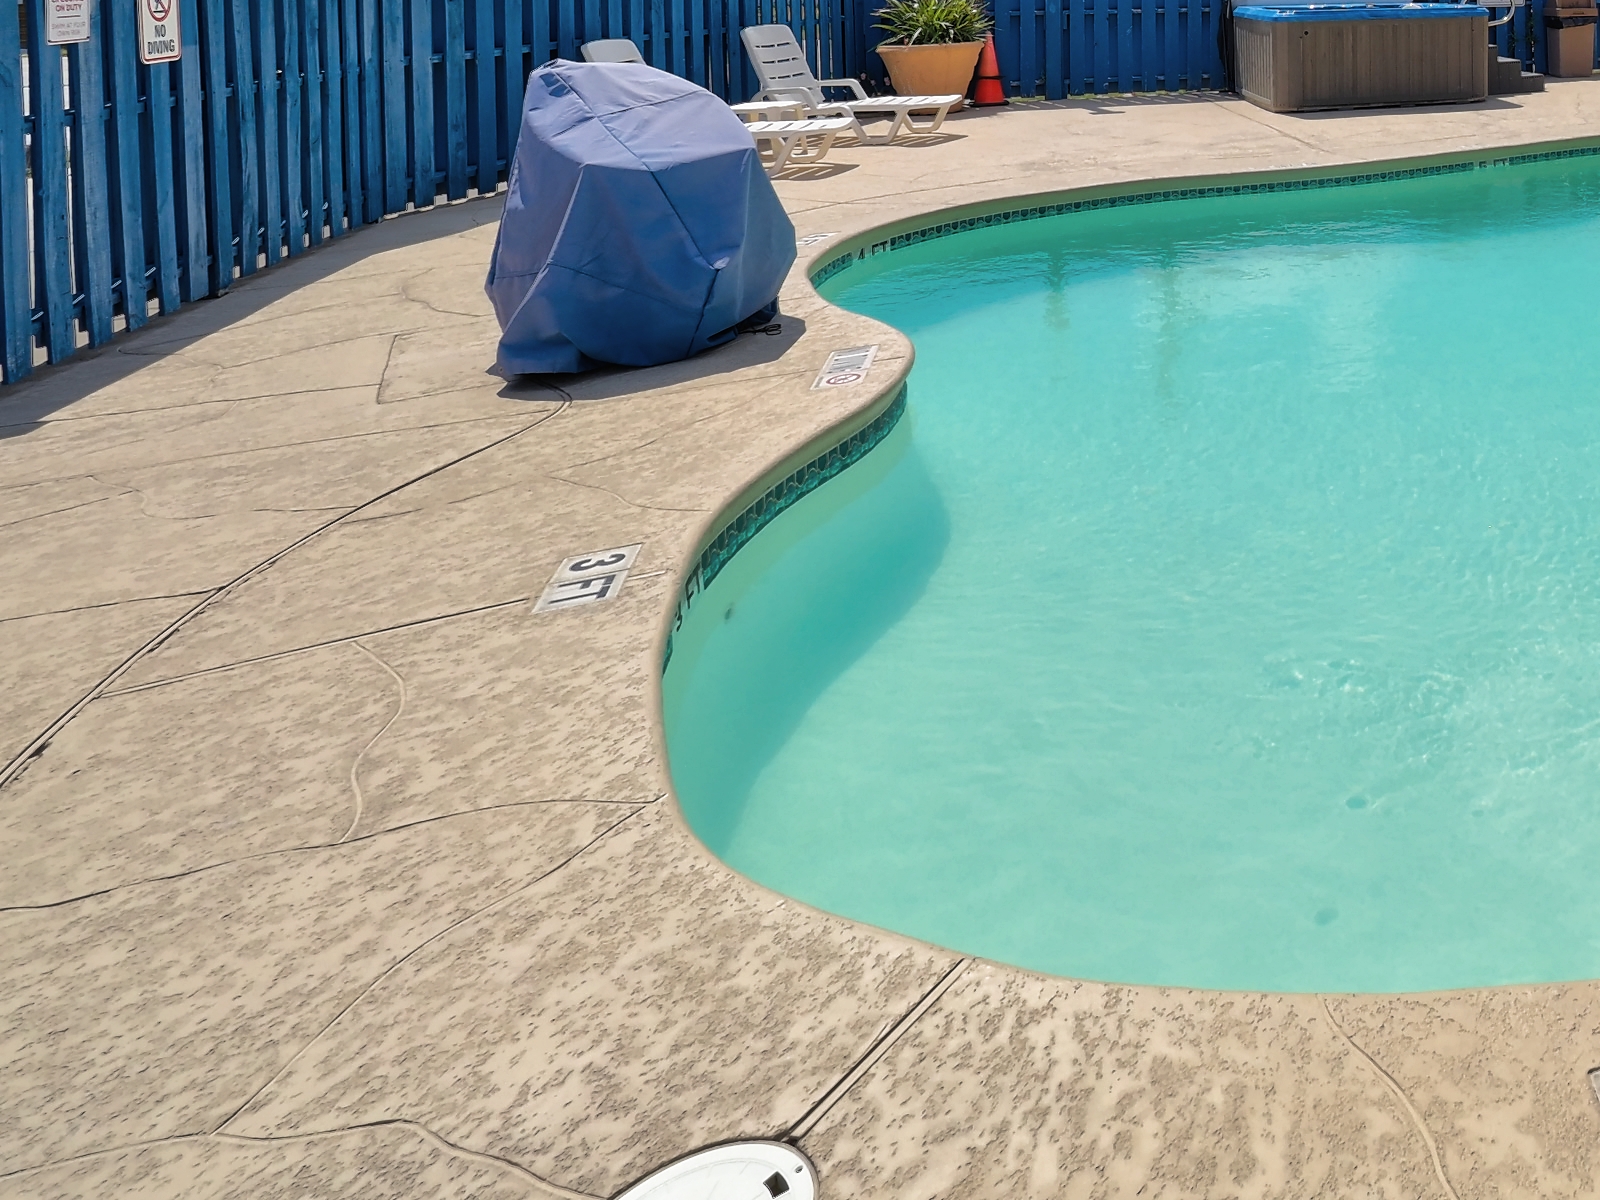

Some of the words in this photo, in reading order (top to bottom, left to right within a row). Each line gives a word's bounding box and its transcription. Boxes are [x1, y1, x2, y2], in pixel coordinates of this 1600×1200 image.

[56, 4, 65, 12] ON
[66, 4, 82, 12] DUTY
[154, 24, 167, 38] NO
[147, 39, 175, 55] DIVING
[871, 240, 888, 256] FT
[568, 553, 626, 572] 3
[548, 574, 617, 605] FT
[685, 562, 701, 610] FT
